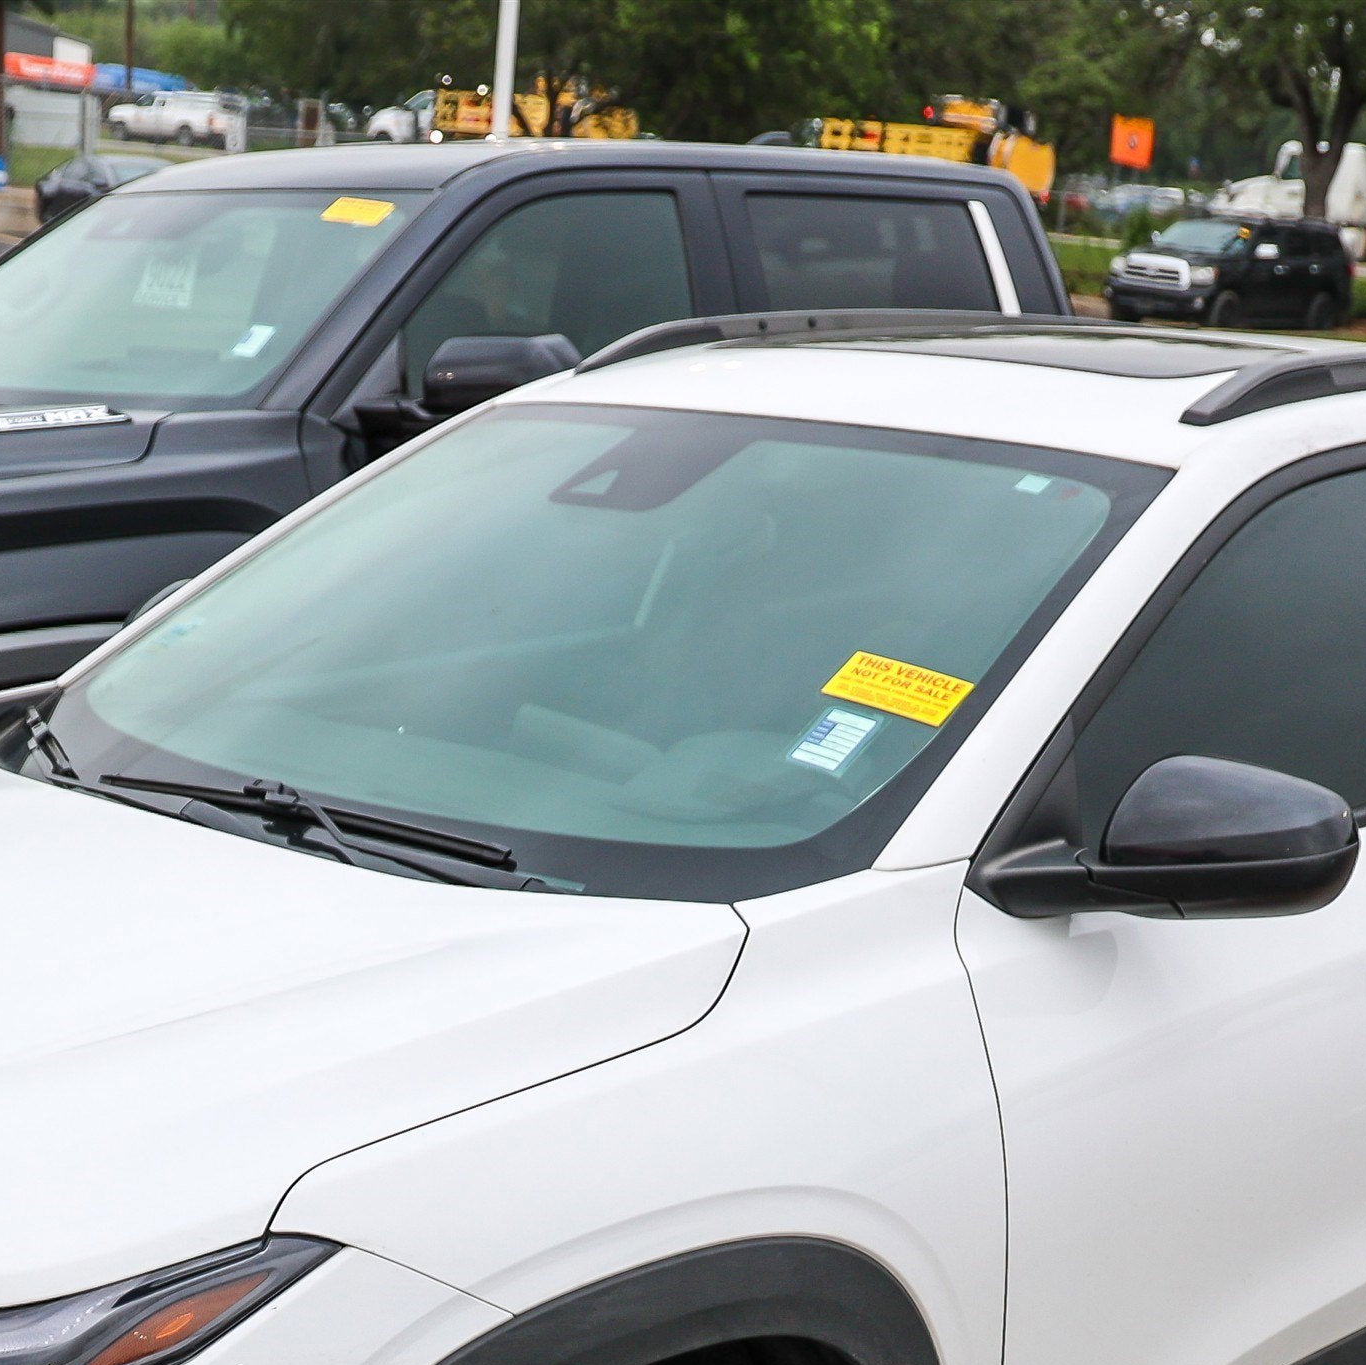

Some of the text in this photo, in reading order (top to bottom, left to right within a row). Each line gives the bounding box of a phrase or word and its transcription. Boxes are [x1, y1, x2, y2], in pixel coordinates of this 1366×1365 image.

[851, 667, 878, 681] NOT
[881, 674, 912, 690] FOR
[914, 685, 953, 701] SALE
[856, 655, 894, 671] THIS
[896, 665, 963, 694] VEHICLE
